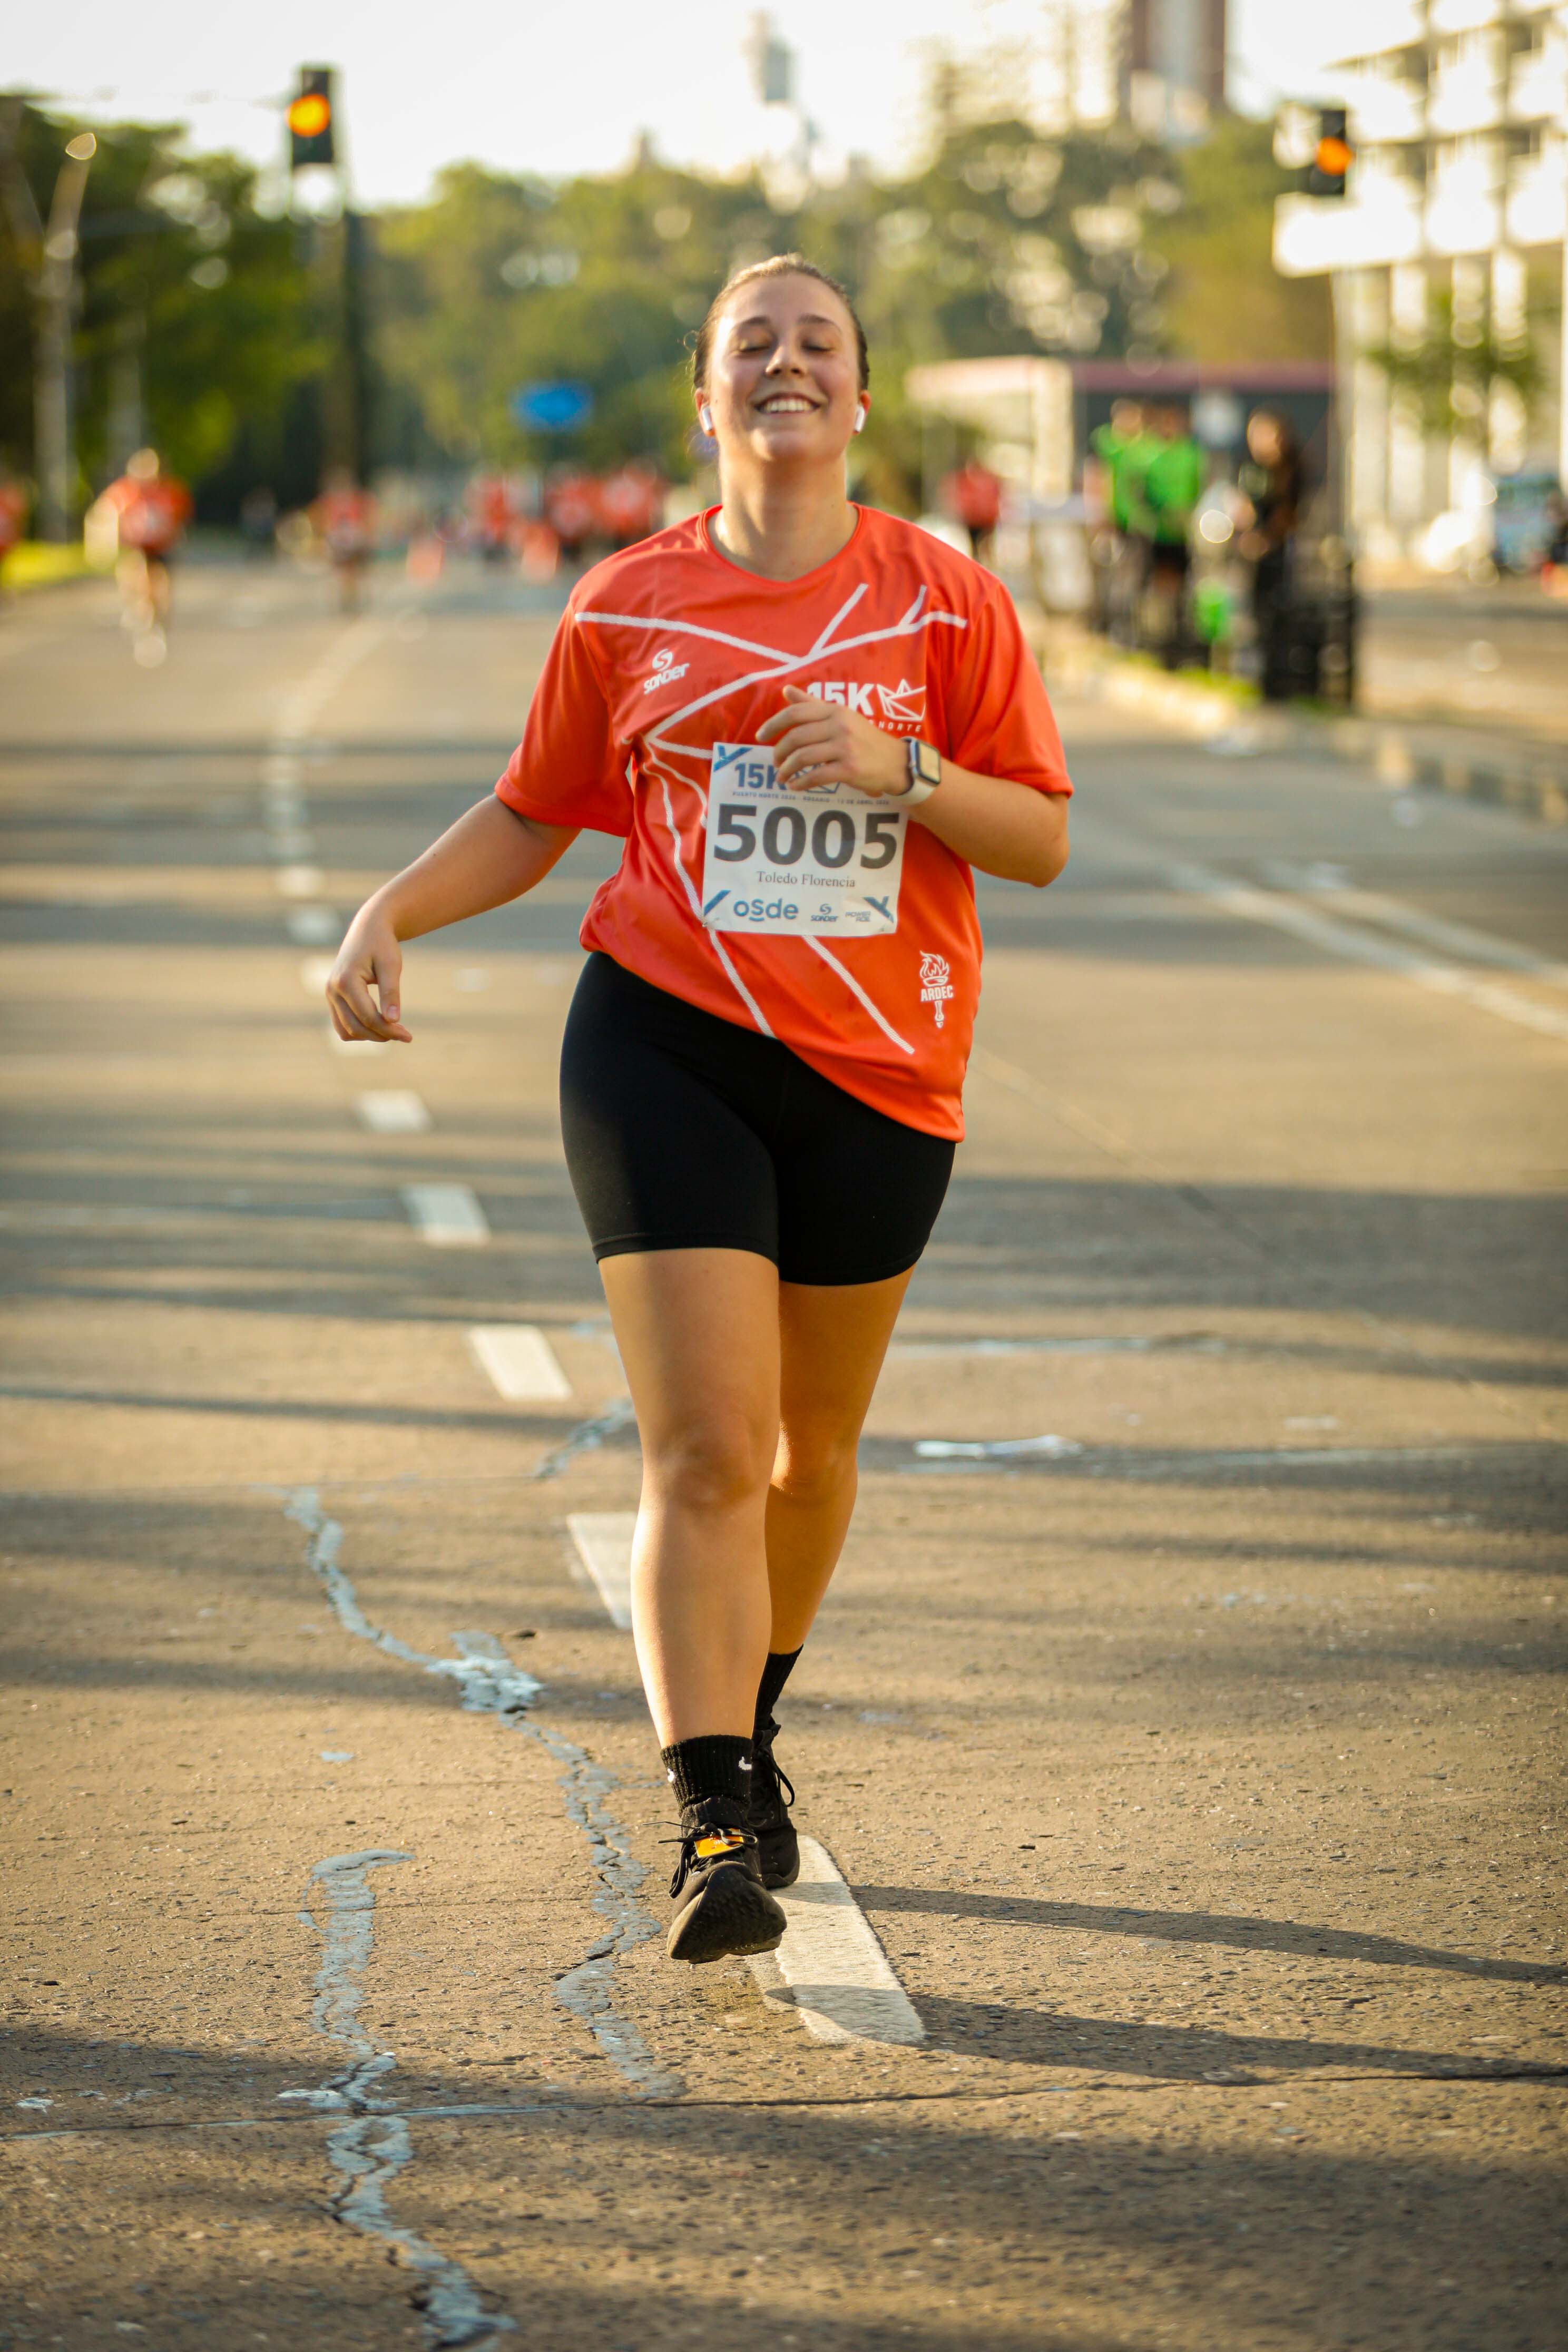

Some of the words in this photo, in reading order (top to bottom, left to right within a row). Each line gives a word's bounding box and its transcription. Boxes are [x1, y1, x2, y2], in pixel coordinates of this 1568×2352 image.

[878, 721, 922, 732] NORTE
[734, 762, 787, 790] 15K
[713, 803, 900, 869] 5005
[757, 870, 798, 885] Toledo
[801, 873, 856, 887] Florencia
[733, 897, 799, 922] osde
[920, 985, 954, 1002] ARDEC
